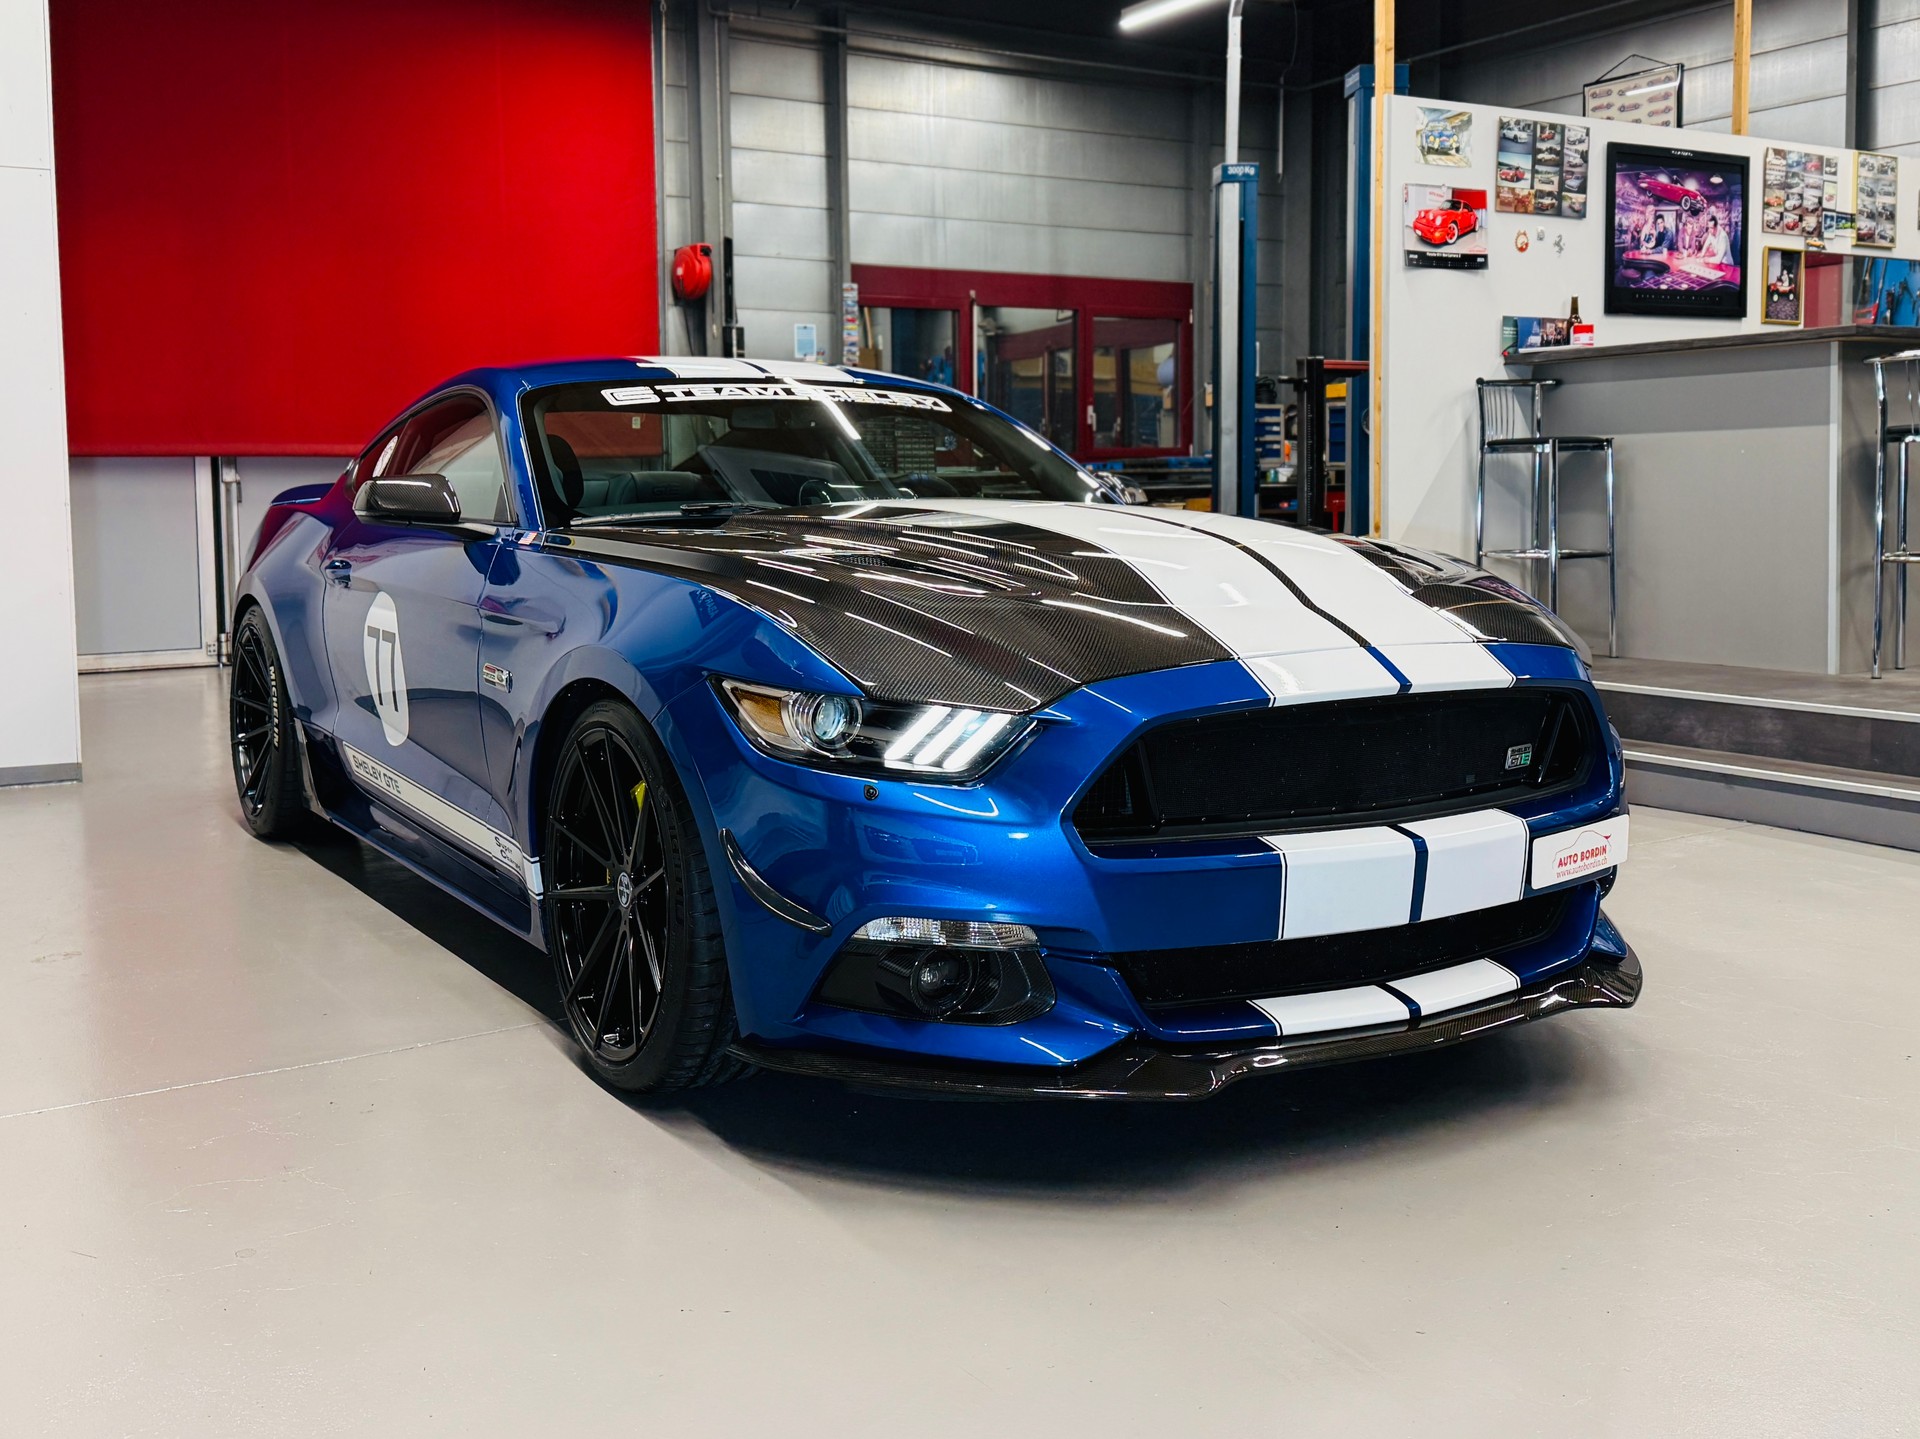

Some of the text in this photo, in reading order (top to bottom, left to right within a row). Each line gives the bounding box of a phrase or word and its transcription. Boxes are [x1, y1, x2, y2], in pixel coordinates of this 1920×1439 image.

[655, 383, 796, 402] TEAM
[367, 625, 399, 712] 77
[268, 665, 281, 748] MICHELIN
[352, 755, 401, 794] SHELBY GTE
[1557, 844, 1607, 868] AUTO BORDIN
